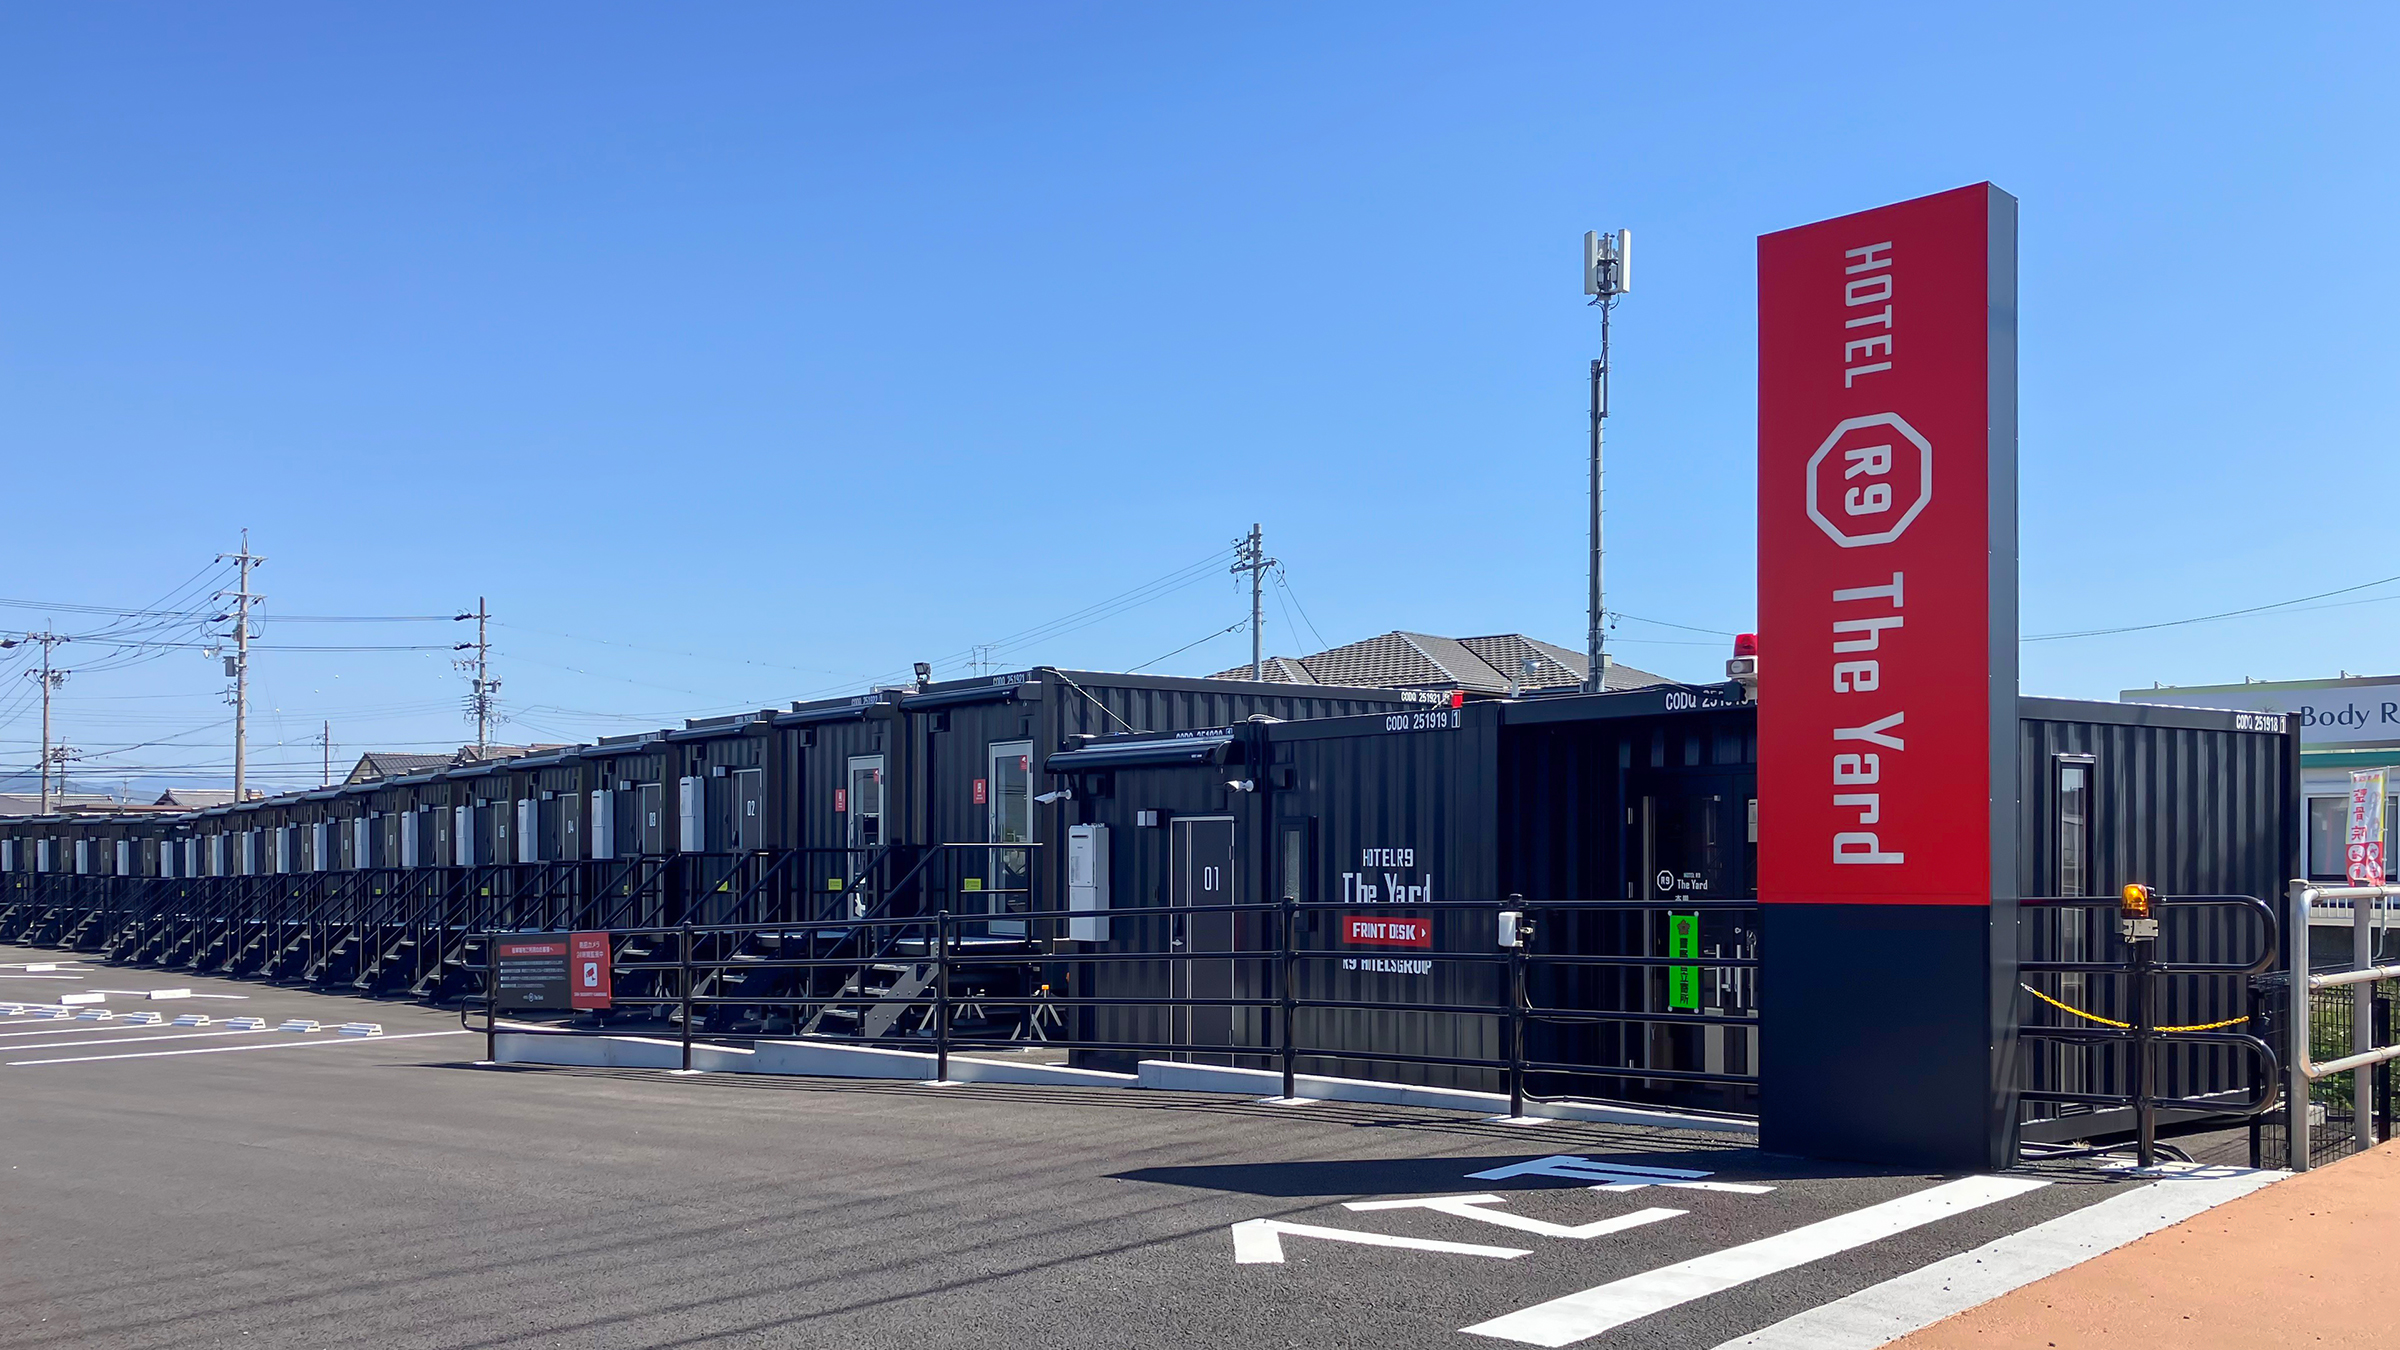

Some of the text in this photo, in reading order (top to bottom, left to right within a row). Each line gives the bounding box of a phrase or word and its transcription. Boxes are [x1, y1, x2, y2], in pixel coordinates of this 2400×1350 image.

[1833, 241, 1904, 864] HOTEL R9 The Yard
[1418, 692, 1441, 703] 251921
[1386, 715, 1409, 731] CODQ
[1413, 712, 1447, 730] 251919
[2254, 715, 2279, 732] 251918
[2301, 703, 2370, 730] Body
[747, 800, 756, 816] 02
[649, 812, 656, 827] 03
[1204, 866, 1219, 891] 01
[1660, 876, 1670, 885] R9
[1677, 879, 1708, 890] The Yard
[1342, 872, 1431, 903] The Yard
